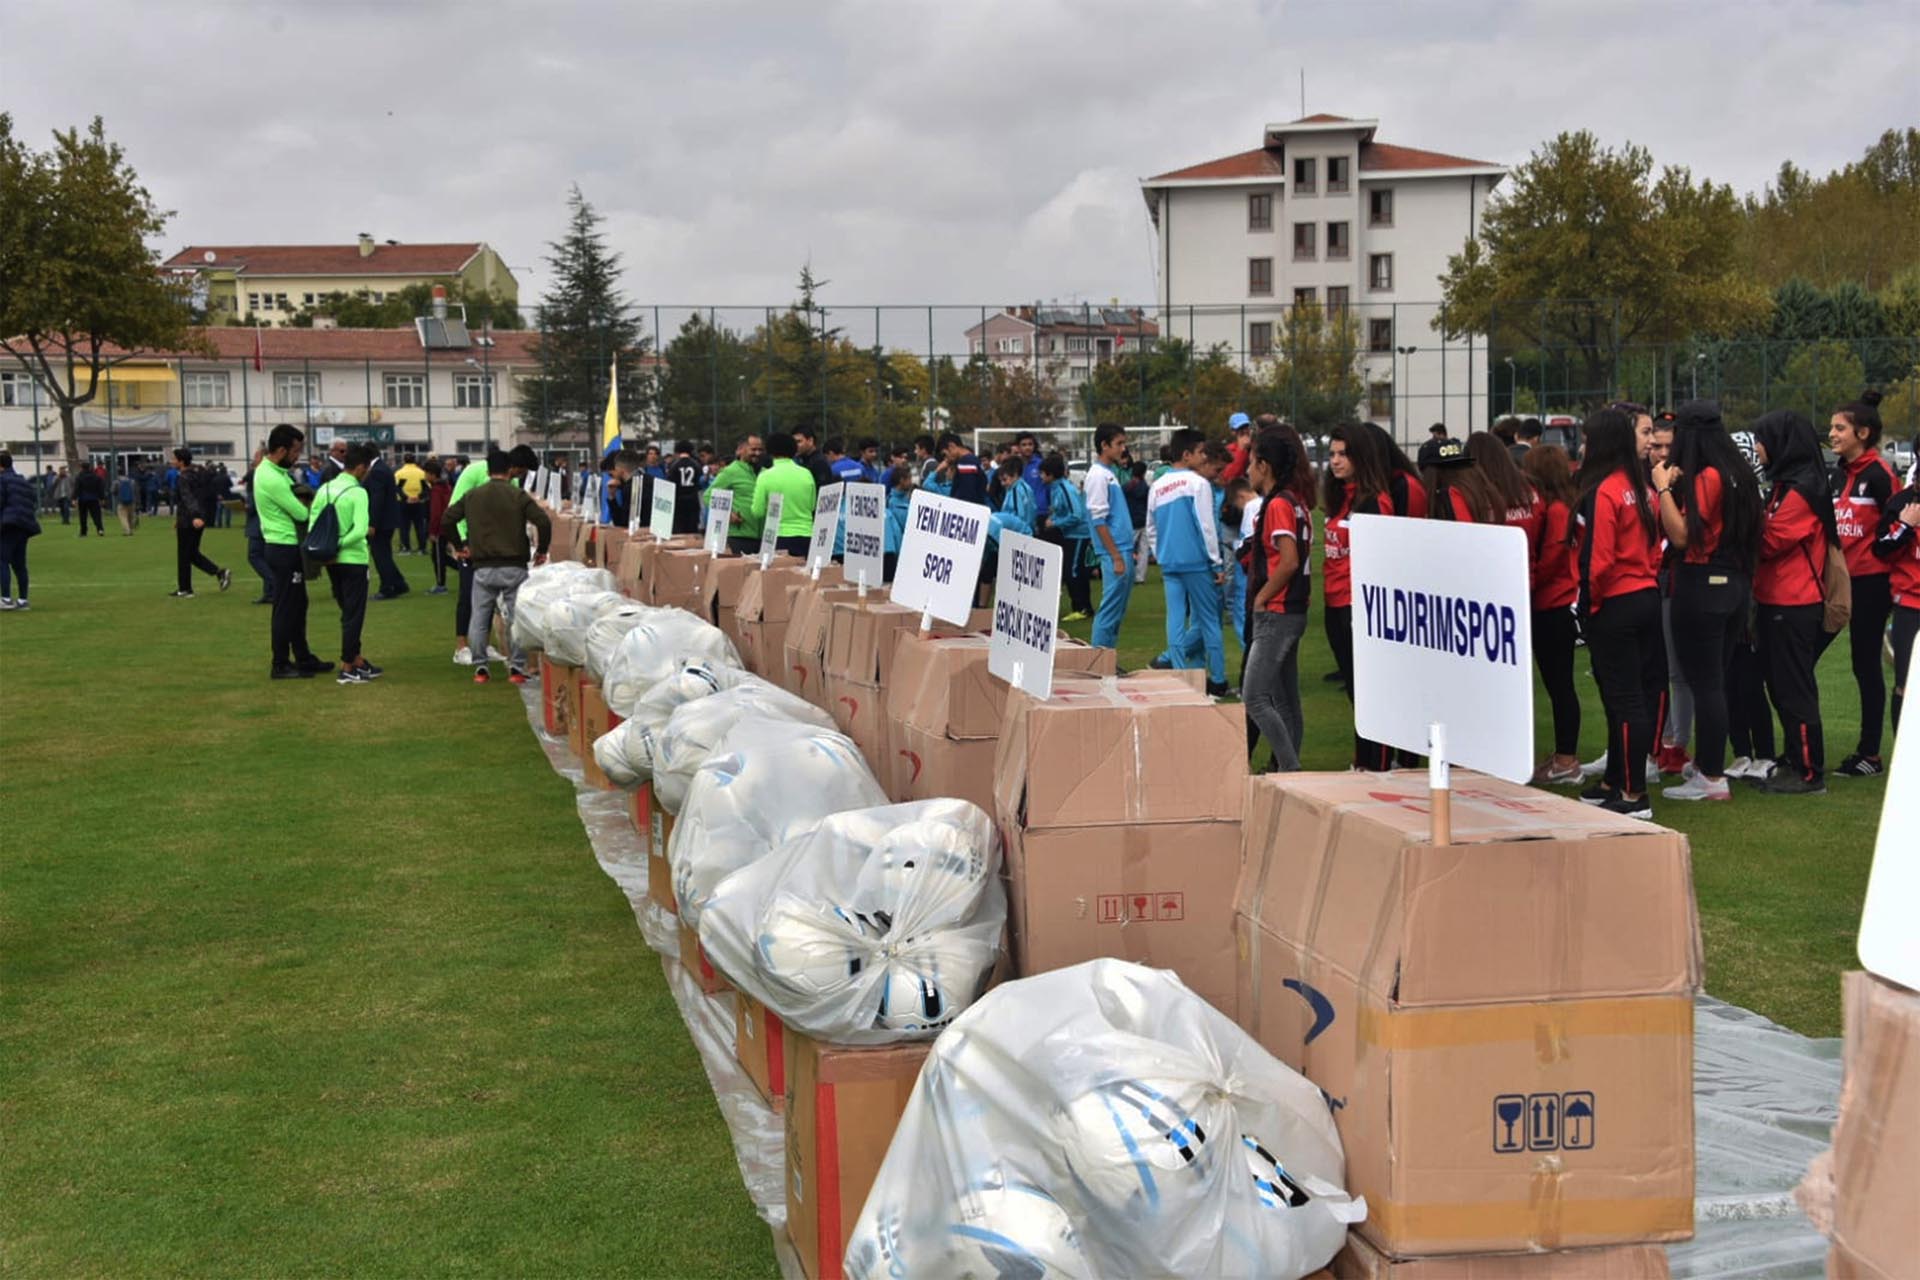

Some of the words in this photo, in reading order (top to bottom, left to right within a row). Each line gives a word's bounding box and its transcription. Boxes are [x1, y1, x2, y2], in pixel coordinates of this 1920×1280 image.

[679, 467, 694, 486] 12
[916, 503, 942, 535] YENİ
[939, 511, 980, 546] MERAM
[923, 552, 953, 585] SPOR
[1011, 548, 1045, 592] YEŞİLYURT
[996, 599, 1023, 645] GENÇLİK
[1032, 615, 1052, 654] SPOR
[1362, 583, 1517, 666] YILDIRIMSPOR
